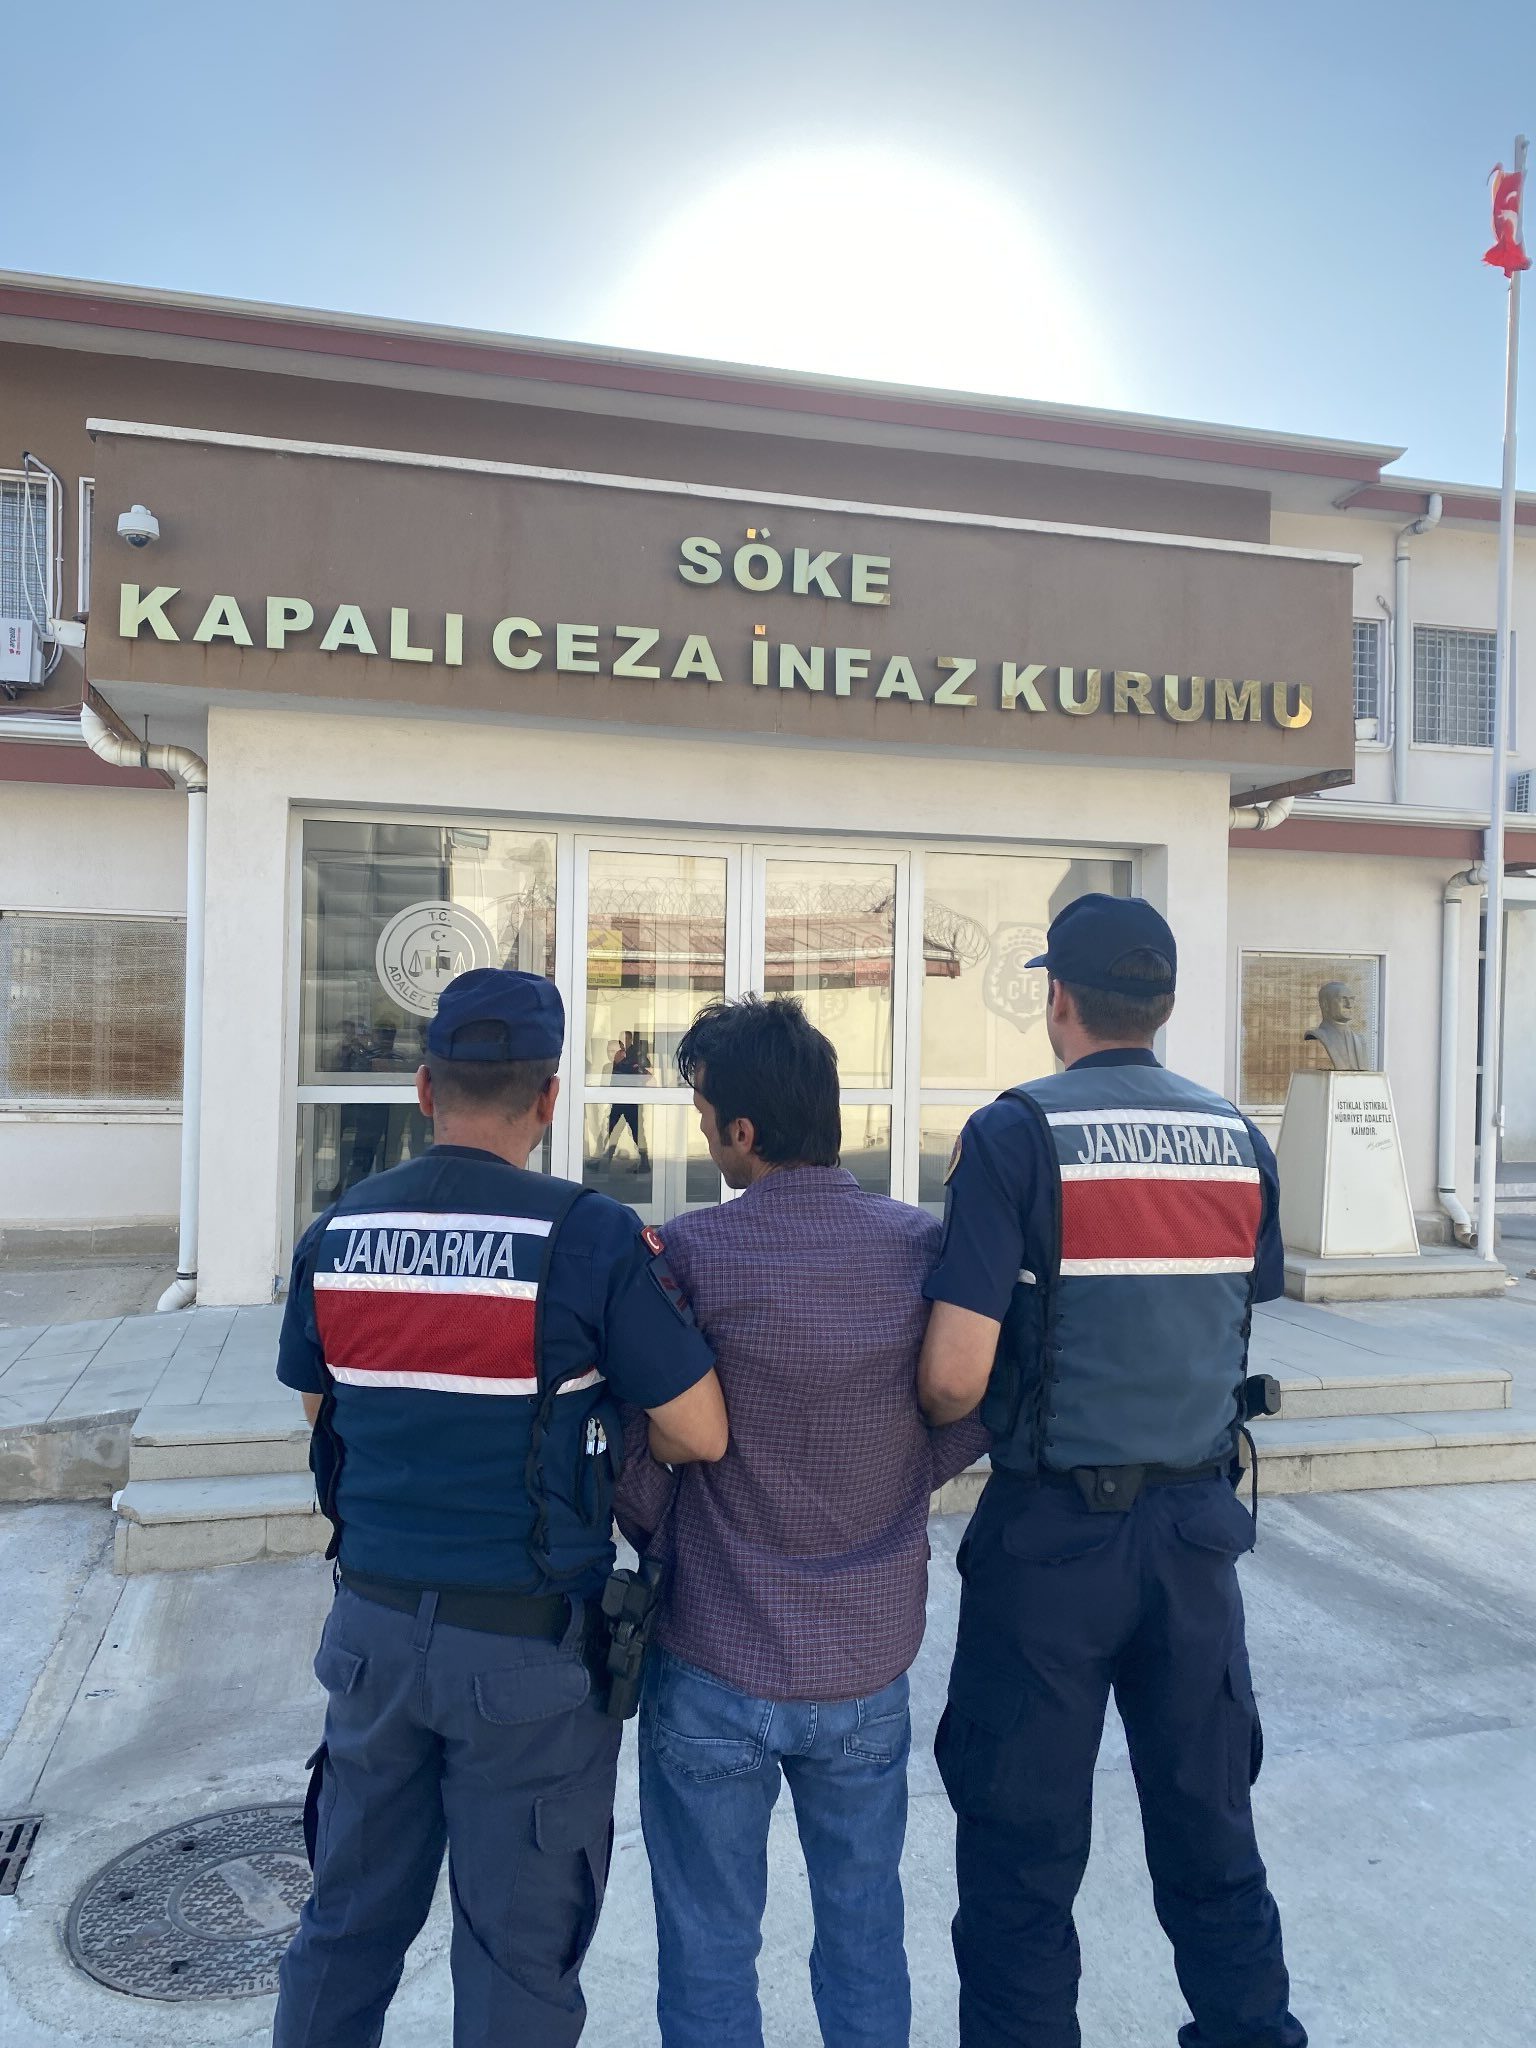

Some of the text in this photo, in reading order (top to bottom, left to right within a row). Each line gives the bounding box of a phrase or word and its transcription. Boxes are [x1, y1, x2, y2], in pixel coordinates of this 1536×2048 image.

[678, 527, 891, 606] SÖKE
[119, 583, 1314, 729] KAPALI CEZA İNFAZ KURUMU
[428, 911, 451, 922] T.C.
[388, 965, 426, 1004] ADALET
[1007, 973, 1041, 1001] CTE
[1364, 1114, 1392, 1123] ADALETLE
[1077, 1124, 1243, 1165] JANDARMA
[333, 1229, 515, 1278] JANDARMA
